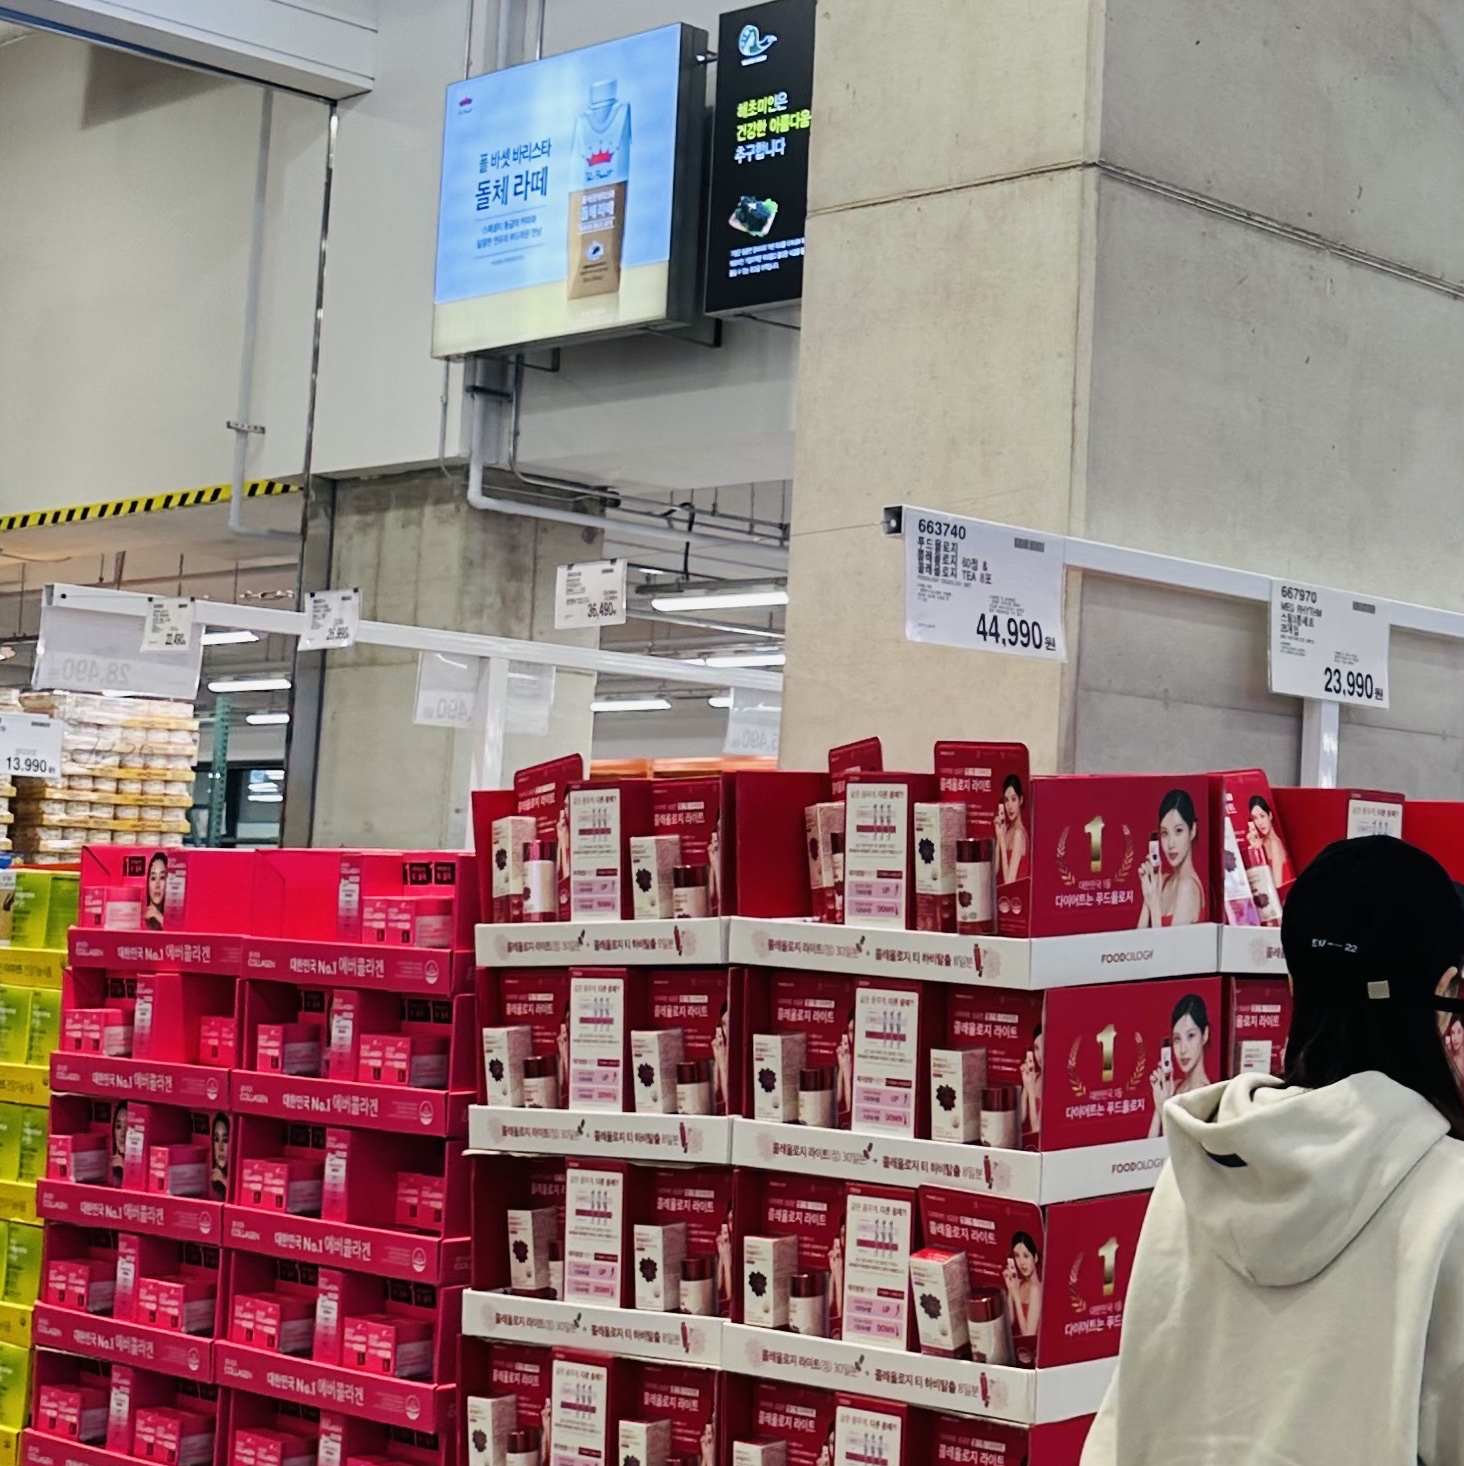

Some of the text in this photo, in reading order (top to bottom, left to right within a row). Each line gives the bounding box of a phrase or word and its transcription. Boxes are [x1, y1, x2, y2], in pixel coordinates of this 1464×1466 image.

[737, 91, 788, 119] 해초미인은
[736, 119, 767, 142] 건강한
[491, 148, 511, 169] 바셋
[512, 138, 552, 165] 바리스타
[734, 137, 786, 164] 추구합니다
[475, 166, 548, 211] 돌체 라떼
[918, 519, 966, 540] 663740
[1084, 816, 1106, 873] 1
[1054, 888, 1134, 908] 다이어트는 푸드올로지
[1100, 950, 1154, 965] FOODOLOGY
[1096, 1023, 1117, 1083] 1
[1065, 1099, 1145, 1120] 다이어트는 푸드올로지
[1098, 1236, 1119, 1296] 1
[1065, 1316, 1104, 1335] 다이어트는
